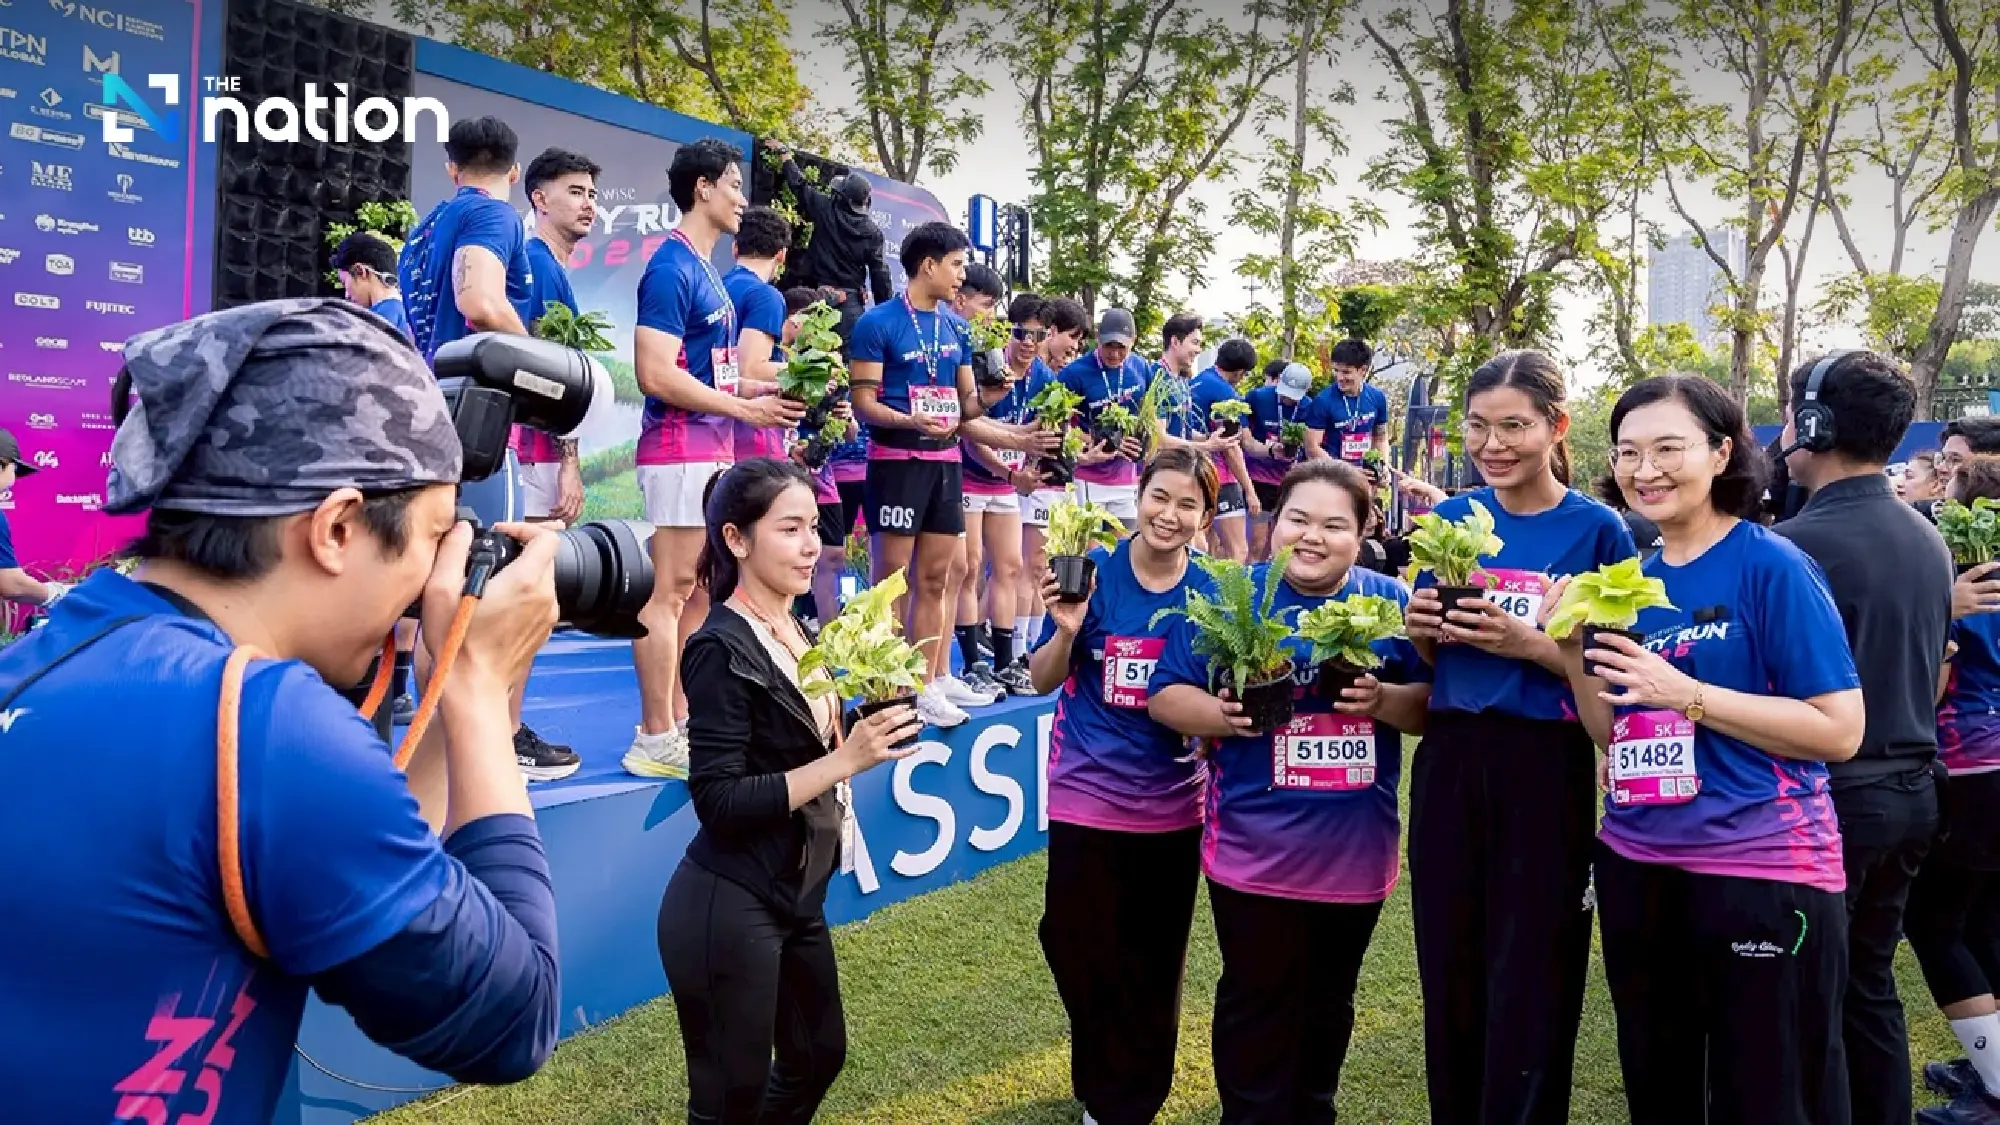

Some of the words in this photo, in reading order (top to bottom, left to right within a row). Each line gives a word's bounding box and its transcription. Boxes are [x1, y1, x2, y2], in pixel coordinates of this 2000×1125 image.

[79, 5, 123, 31] NCI
[633, 203, 683, 235] RU
[18, 295, 55, 306] COLT
[85, 300, 135, 315] FUJITEC
[1804, 416, 1818, 438] 1
[879, 504, 915, 529] GOS
[1034, 508, 1049, 521] GO
[1504, 580, 1521, 592] 5K
[1676, 622, 1729, 645] RUN
[1342, 724, 1357, 735] 5K
[1654, 722, 1673, 737] 5K
[1297, 739, 1368, 760] 51508
[1620, 742, 1684, 769] 51482
